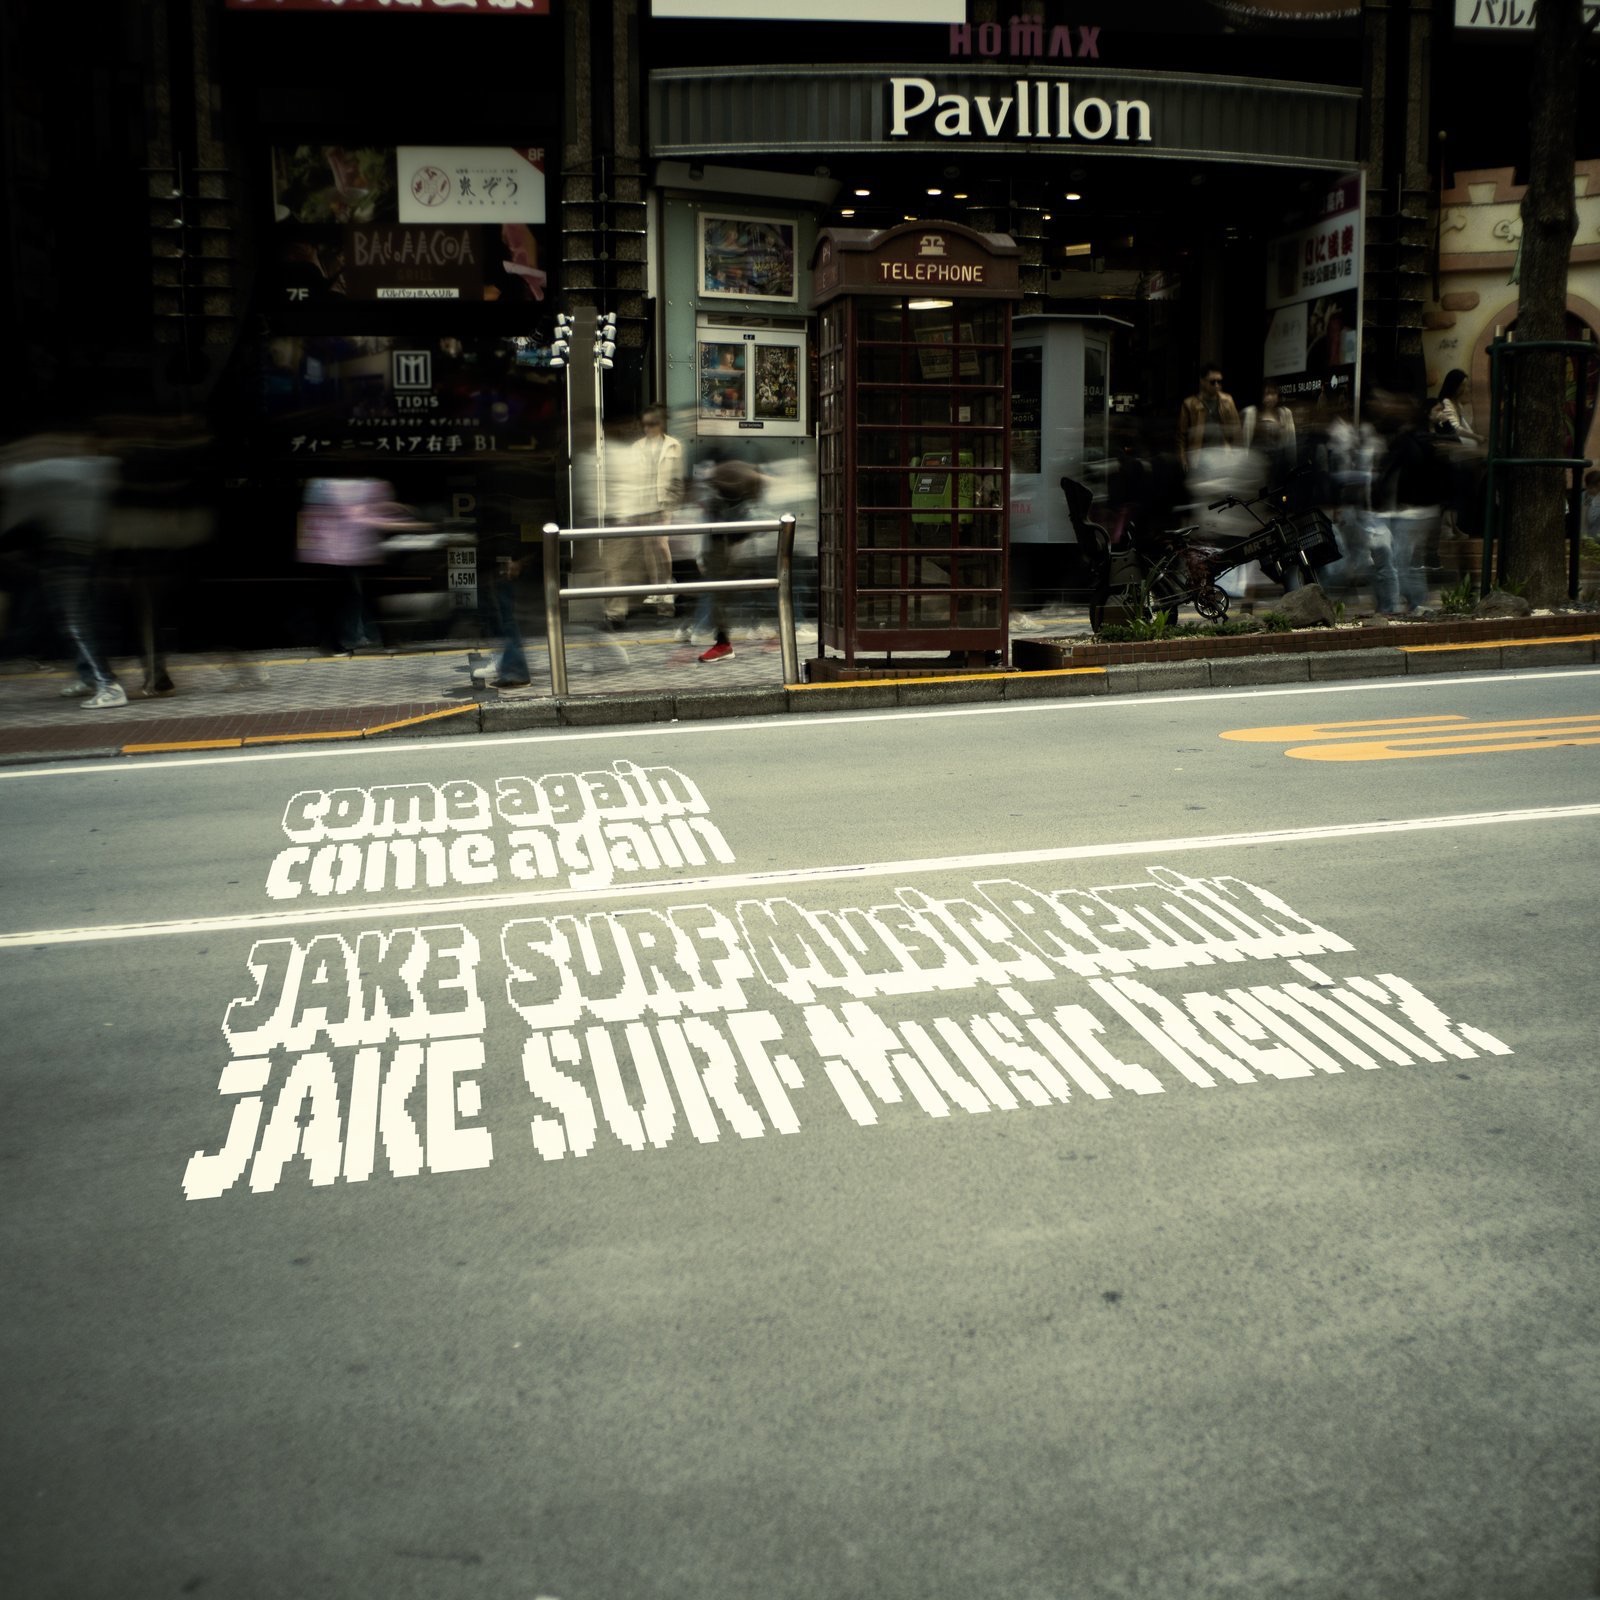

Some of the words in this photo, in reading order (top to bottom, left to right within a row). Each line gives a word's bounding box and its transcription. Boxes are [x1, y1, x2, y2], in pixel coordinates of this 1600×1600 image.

[949, 14, 1102, 59] HOMAX
[880, 262, 984, 282] TELEPHONE
[286, 288, 311, 301] 7F
[474, 434, 496, 451] B1
[452, 493, 476, 520] P
